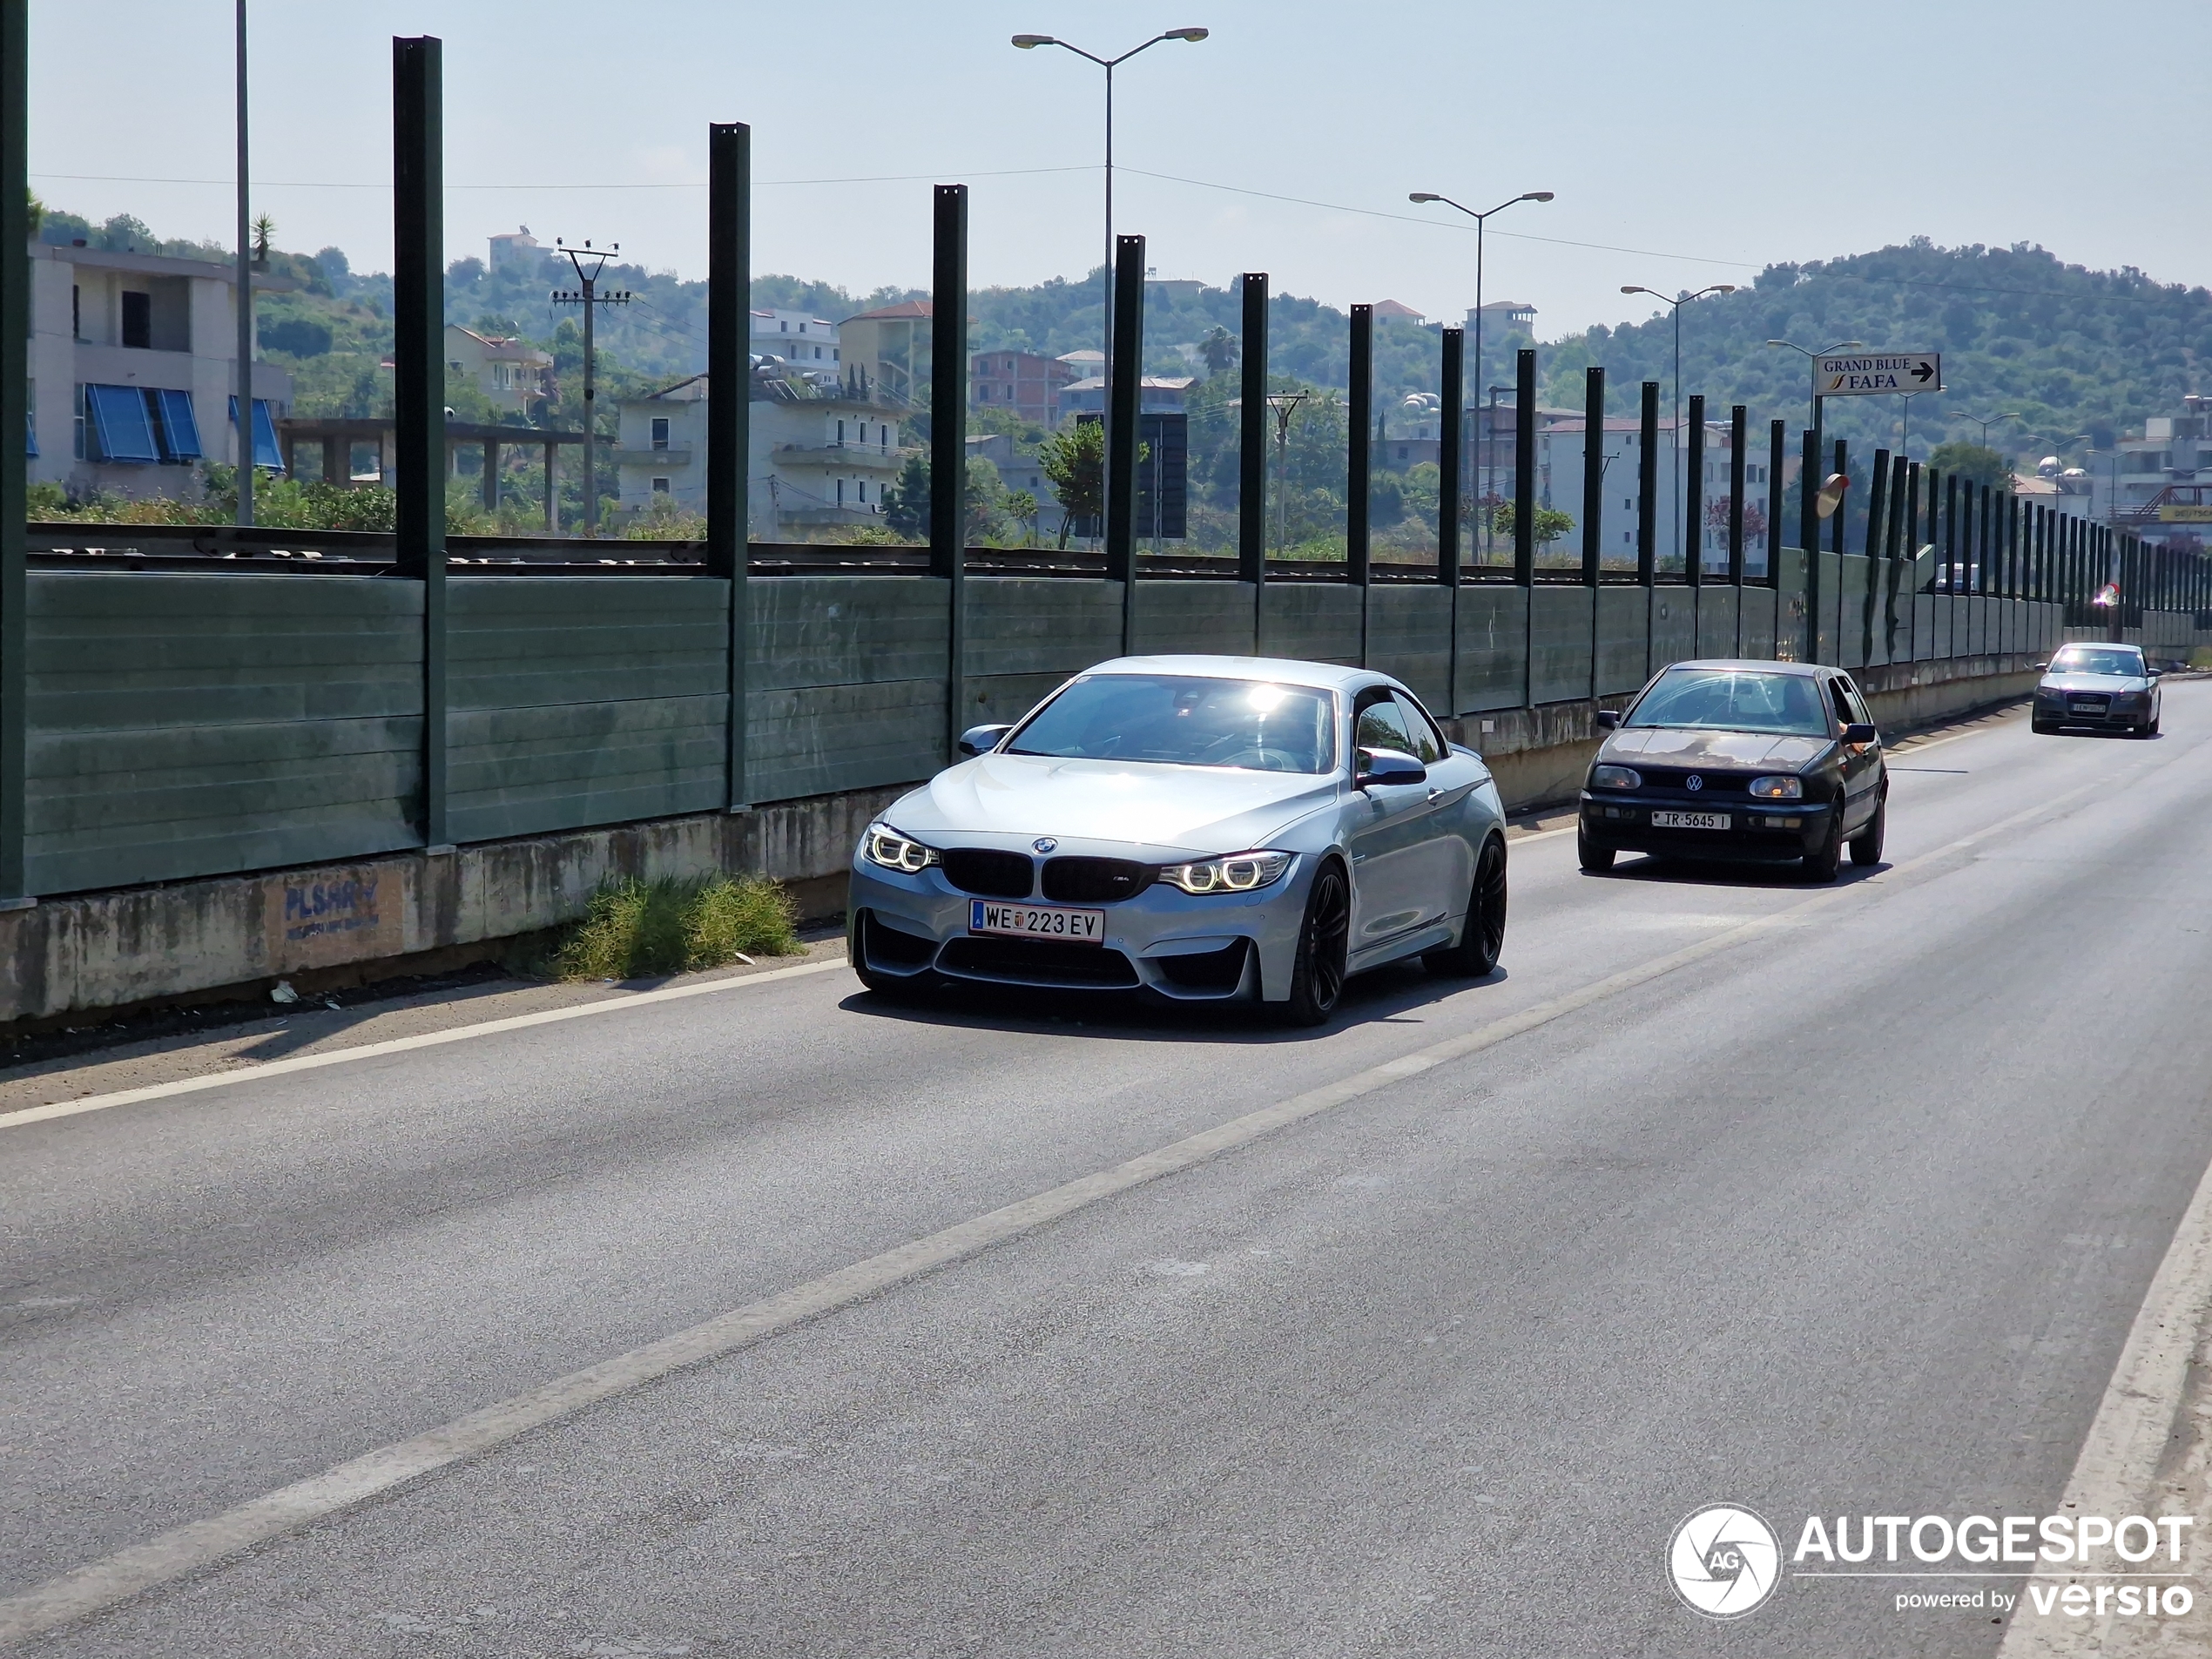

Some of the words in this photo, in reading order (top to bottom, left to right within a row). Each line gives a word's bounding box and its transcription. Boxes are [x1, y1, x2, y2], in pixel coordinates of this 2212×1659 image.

[1824, 360, 1872, 373] GRAND
[1876, 358, 1911, 370] BLUE
[1849, 374, 1898, 389] FAFA
[986, 907, 1012, 928] WE
[1028, 912, 1064, 934] 223
[1070, 915, 1096, 936] EV
